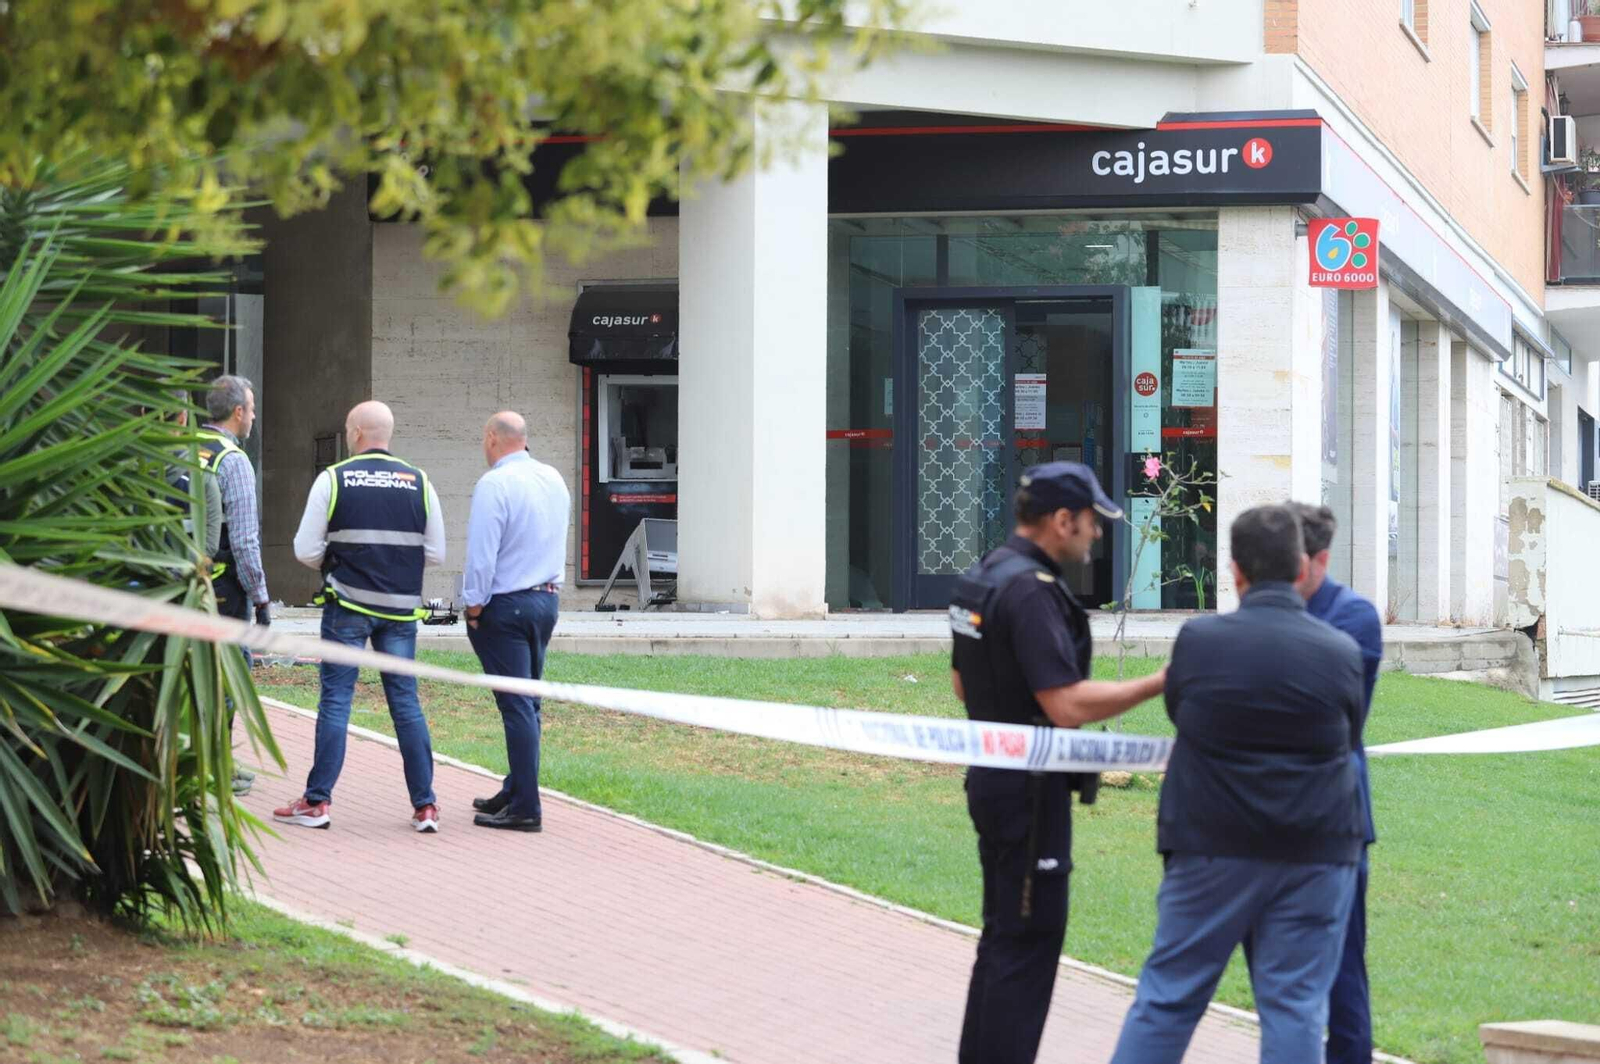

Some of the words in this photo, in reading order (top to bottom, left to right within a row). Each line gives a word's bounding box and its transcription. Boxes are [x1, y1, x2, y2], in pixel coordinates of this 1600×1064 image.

[1091, 141, 1238, 183] cajasur
[1312, 272, 1341, 283] EURO
[1344, 272, 1375, 283] 6000
[592, 315, 649, 328] cajasur
[1136, 376, 1154, 386] caja
[343, 470, 400, 480] POLICIA
[344, 478, 417, 491] NACIONAL
[982, 729, 996, 755] NO
